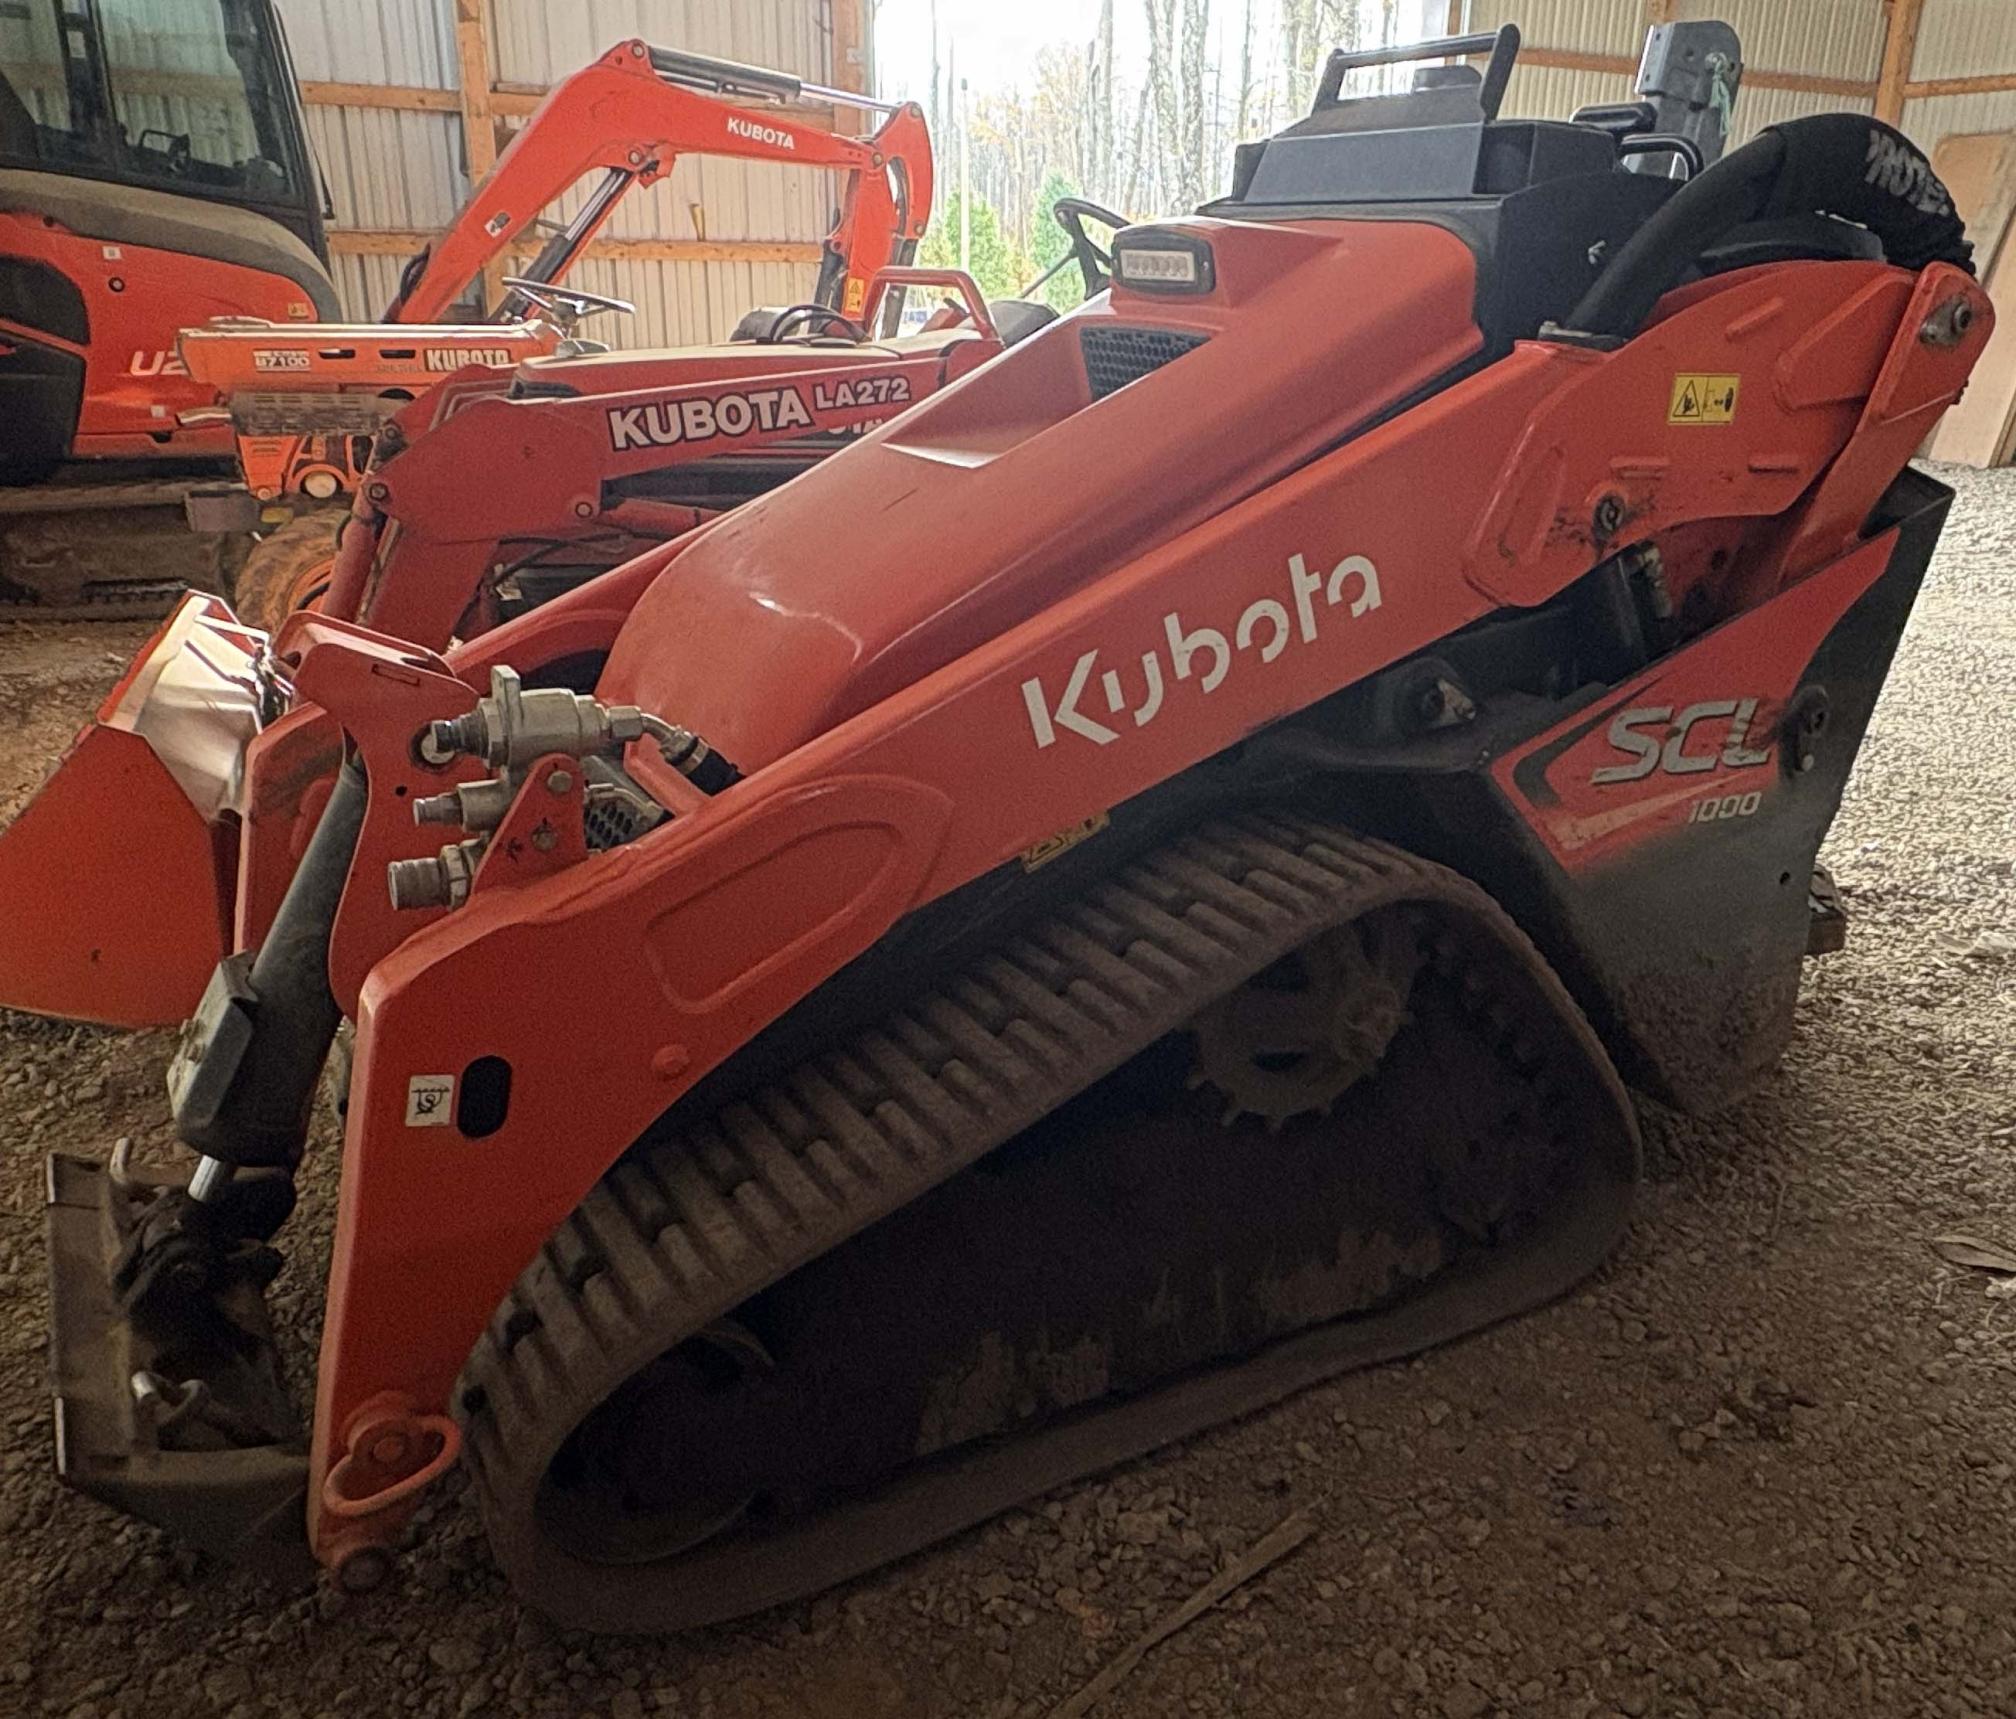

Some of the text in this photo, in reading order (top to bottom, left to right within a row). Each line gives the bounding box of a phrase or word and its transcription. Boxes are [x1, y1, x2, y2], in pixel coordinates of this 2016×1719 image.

[727, 117, 795, 150] KUBOTA
[607, 376, 911, 450] KUBOTA LA272
[1021, 553, 1382, 749] Kubota
[1590, 698, 1772, 786] SCL
[1687, 791, 1762, 824] 1000
